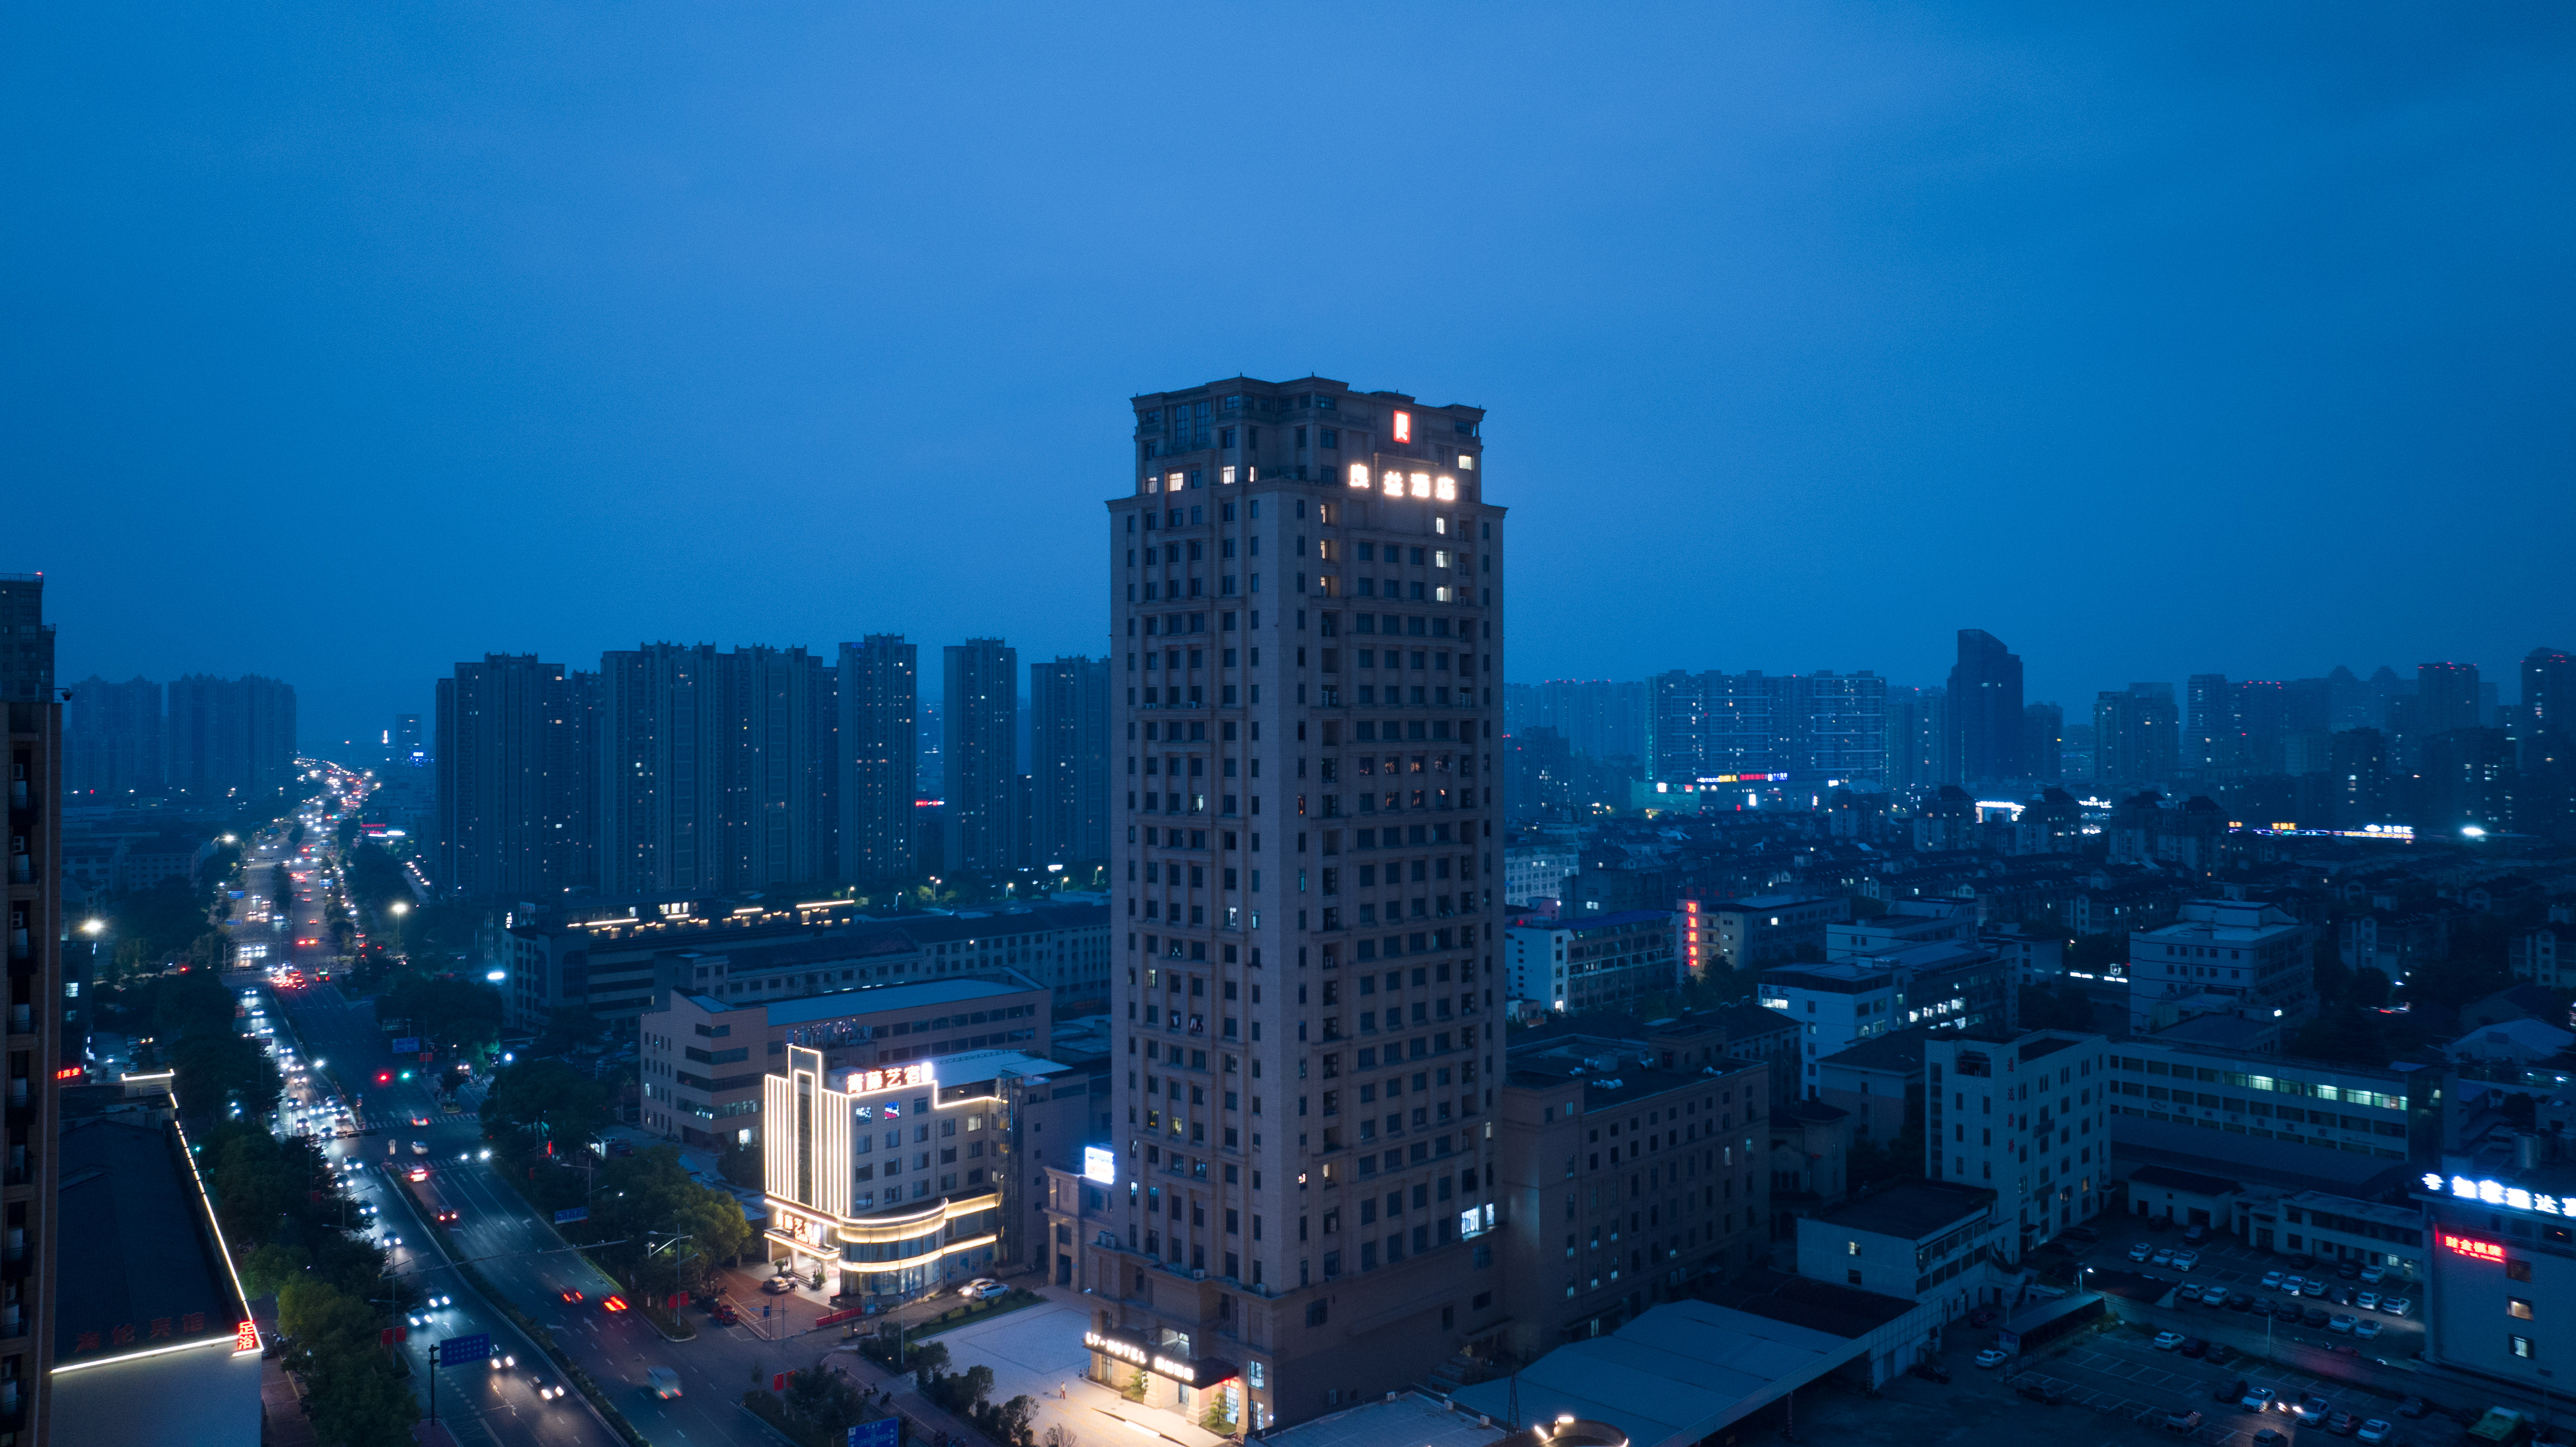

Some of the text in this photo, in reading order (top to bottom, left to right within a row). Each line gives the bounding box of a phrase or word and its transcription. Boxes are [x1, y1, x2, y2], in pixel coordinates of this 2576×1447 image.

[1350, 464, 1455, 500] 良益酒店
[238, 1321, 255, 1350] 足浴
[1085, 1332, 1147, 1364] LY-HOTEL
